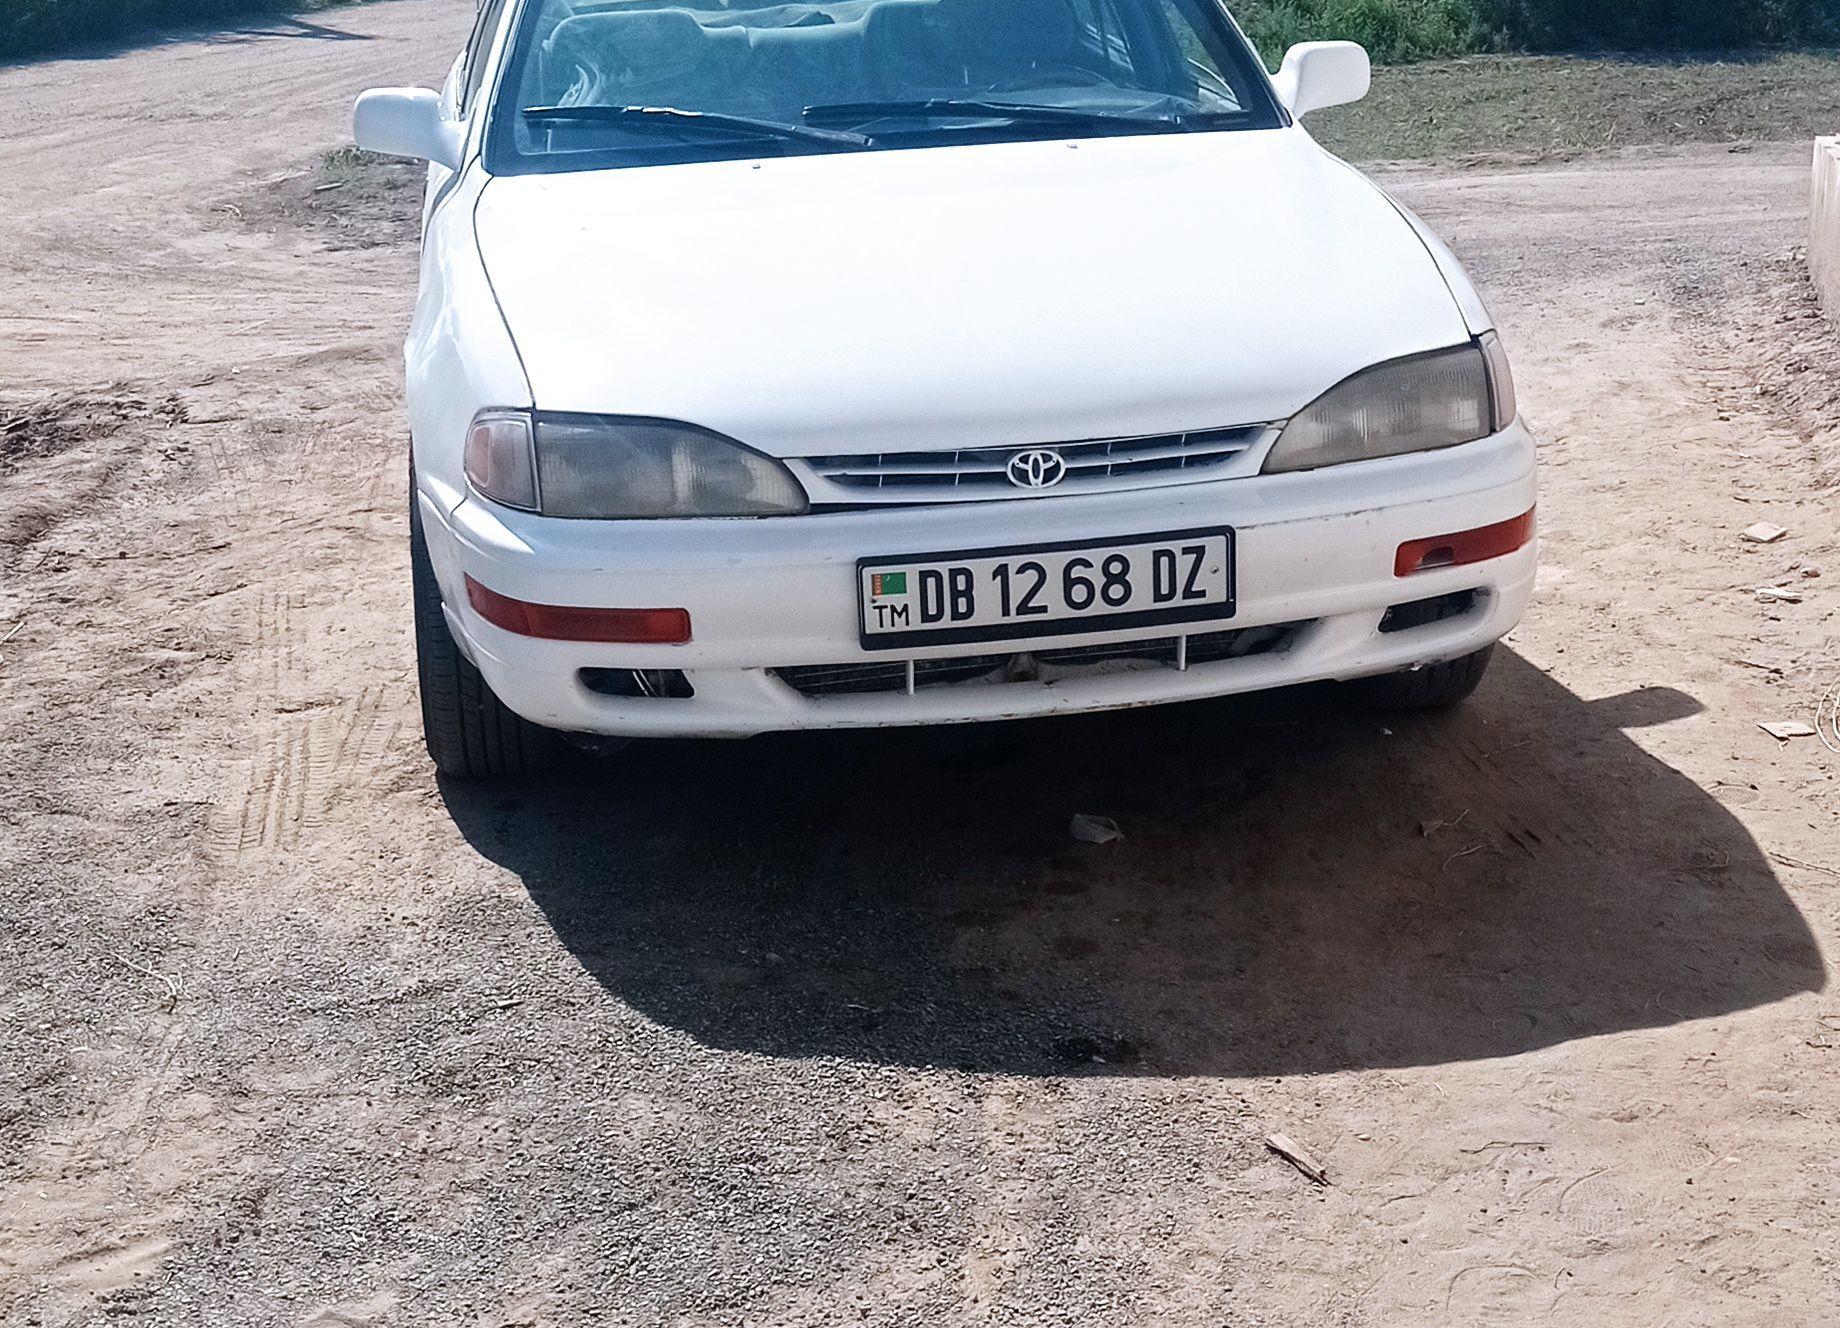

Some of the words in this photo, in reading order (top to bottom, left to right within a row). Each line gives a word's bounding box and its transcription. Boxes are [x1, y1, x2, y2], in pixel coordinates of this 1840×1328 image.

[918, 567, 975, 624] DB
[991, 561, 1048, 617] 12
[1062, 553, 1132, 611] 68
[1152, 544, 1207, 603] DZ
[873, 603, 909, 628] TM
